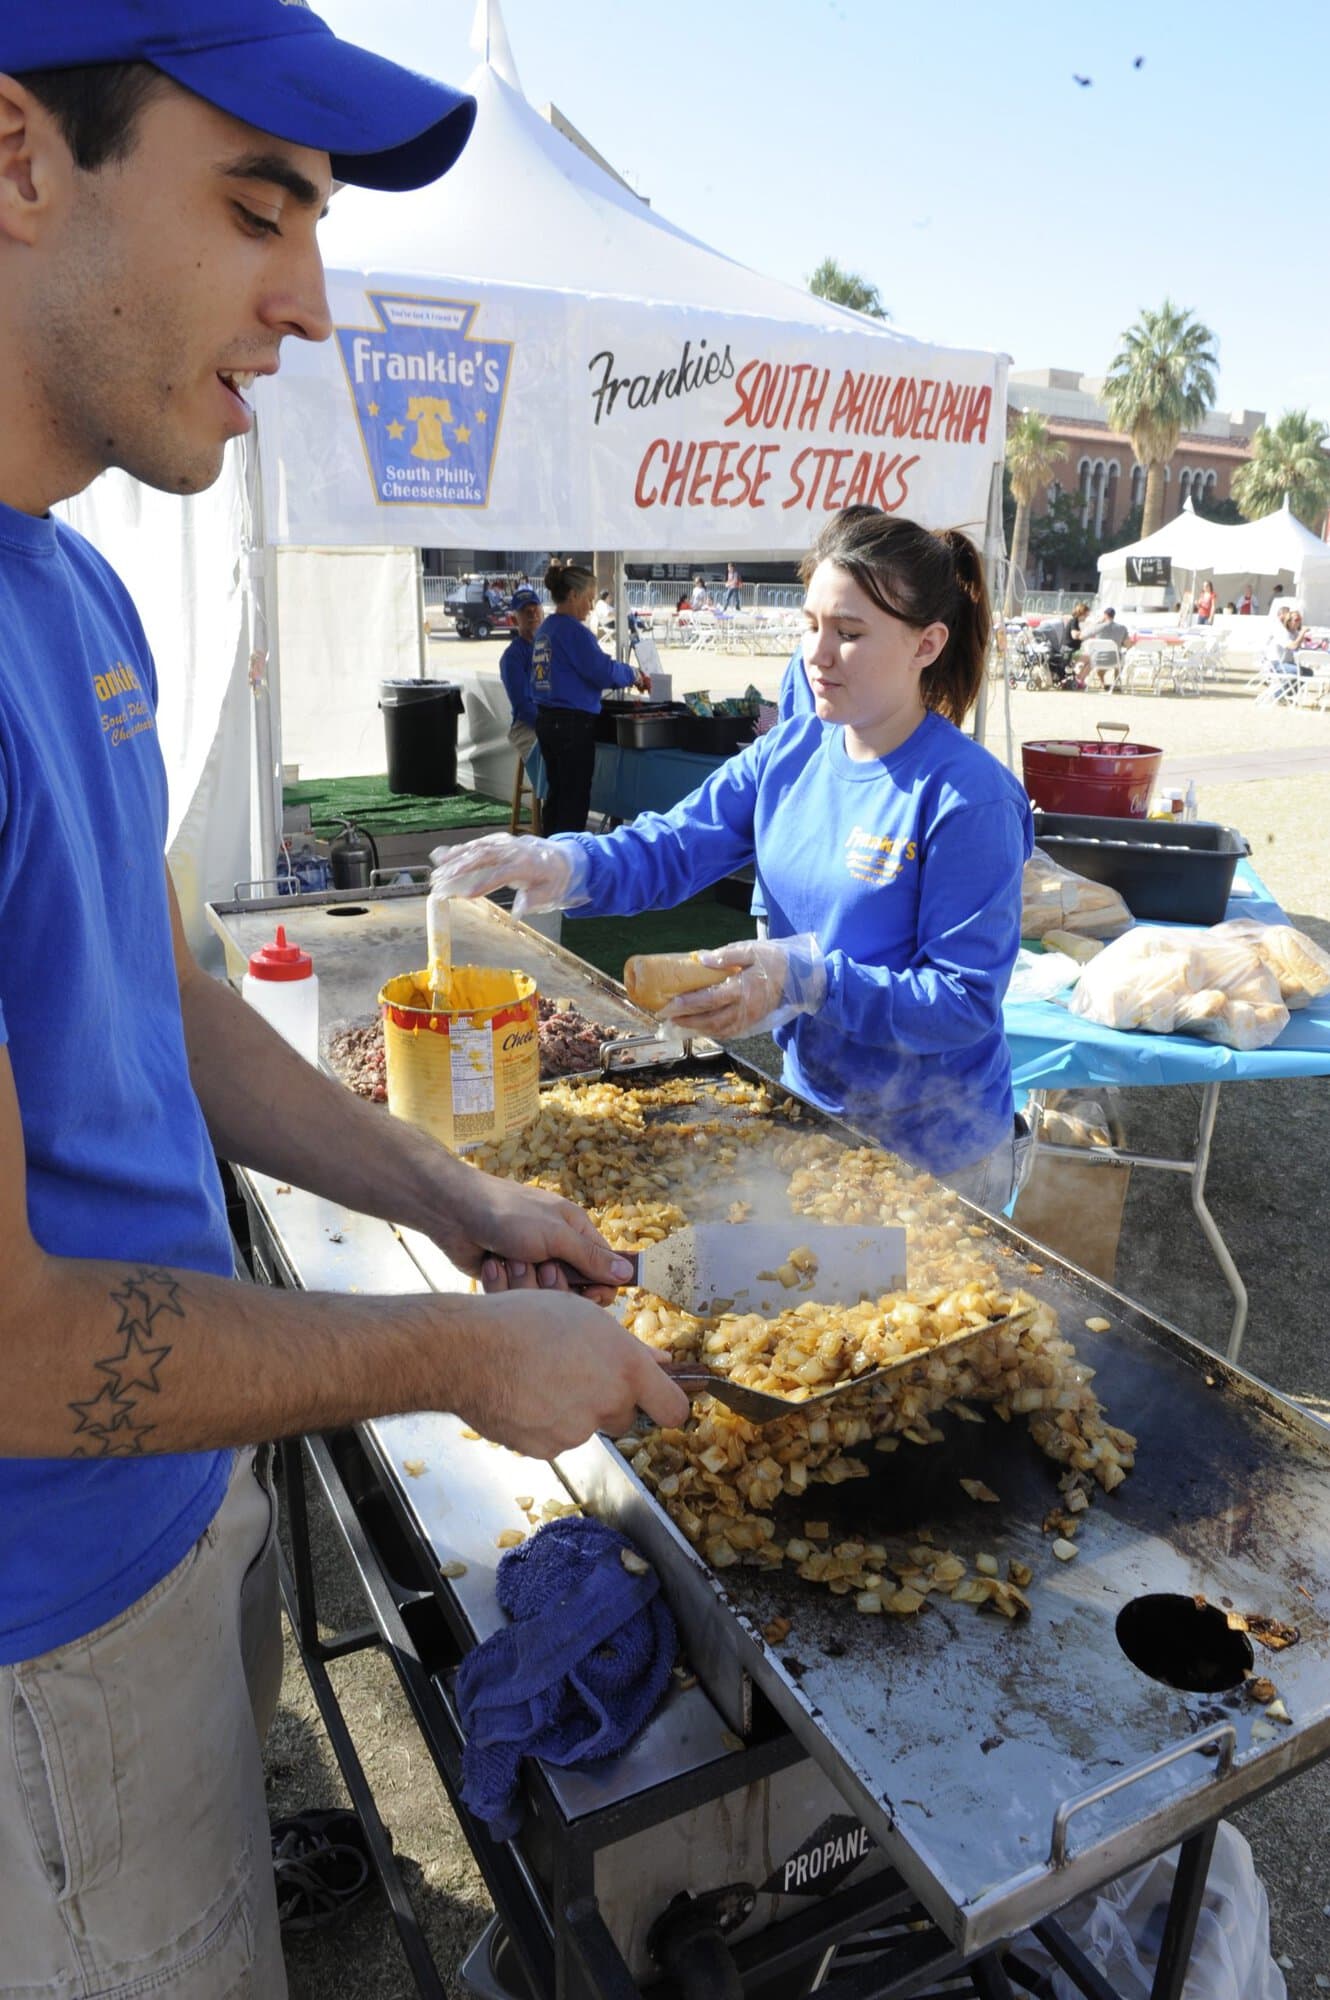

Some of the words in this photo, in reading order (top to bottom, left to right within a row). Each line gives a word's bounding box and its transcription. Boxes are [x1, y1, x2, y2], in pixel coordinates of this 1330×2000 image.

[353, 337, 500, 394] Frankie's
[588, 339, 735, 426] Frankies
[723, 358, 830, 432] SOUTH
[828, 369, 993, 445] PHILADELPHIA
[382, 482, 482, 501] Cheesesteaks
[386, 465, 430, 482] South
[436, 467, 476, 485] Philly
[633, 438, 781, 511] CHEESE
[781, 446, 921, 513] STEAKS
[784, 1826, 869, 1892] PROPANE
